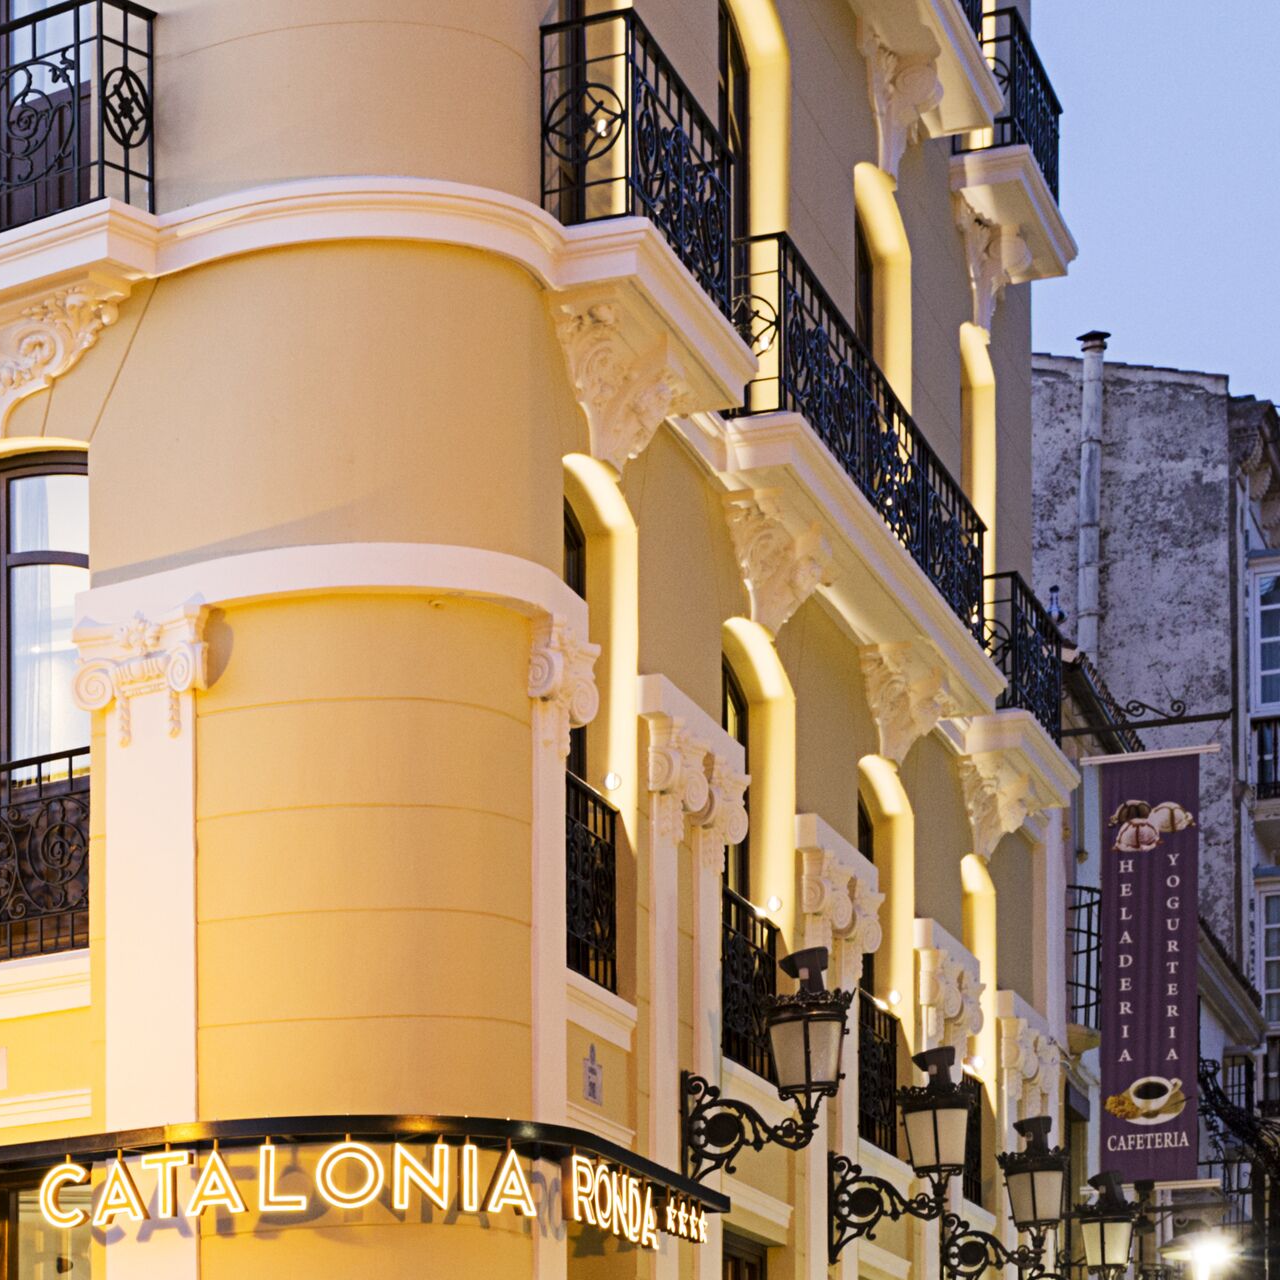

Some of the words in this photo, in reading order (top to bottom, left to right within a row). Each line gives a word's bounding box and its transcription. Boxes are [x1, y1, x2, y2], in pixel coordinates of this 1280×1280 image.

[1119, 859, 1134, 1062] HELADERIA
[1166, 853, 1180, 1060] YOGURTERIA
[39, 1142, 538, 1228] CATALONIA
[572, 1155, 659, 1250] RONDA
[1107, 1131, 1190, 1152] CAFETERIA
